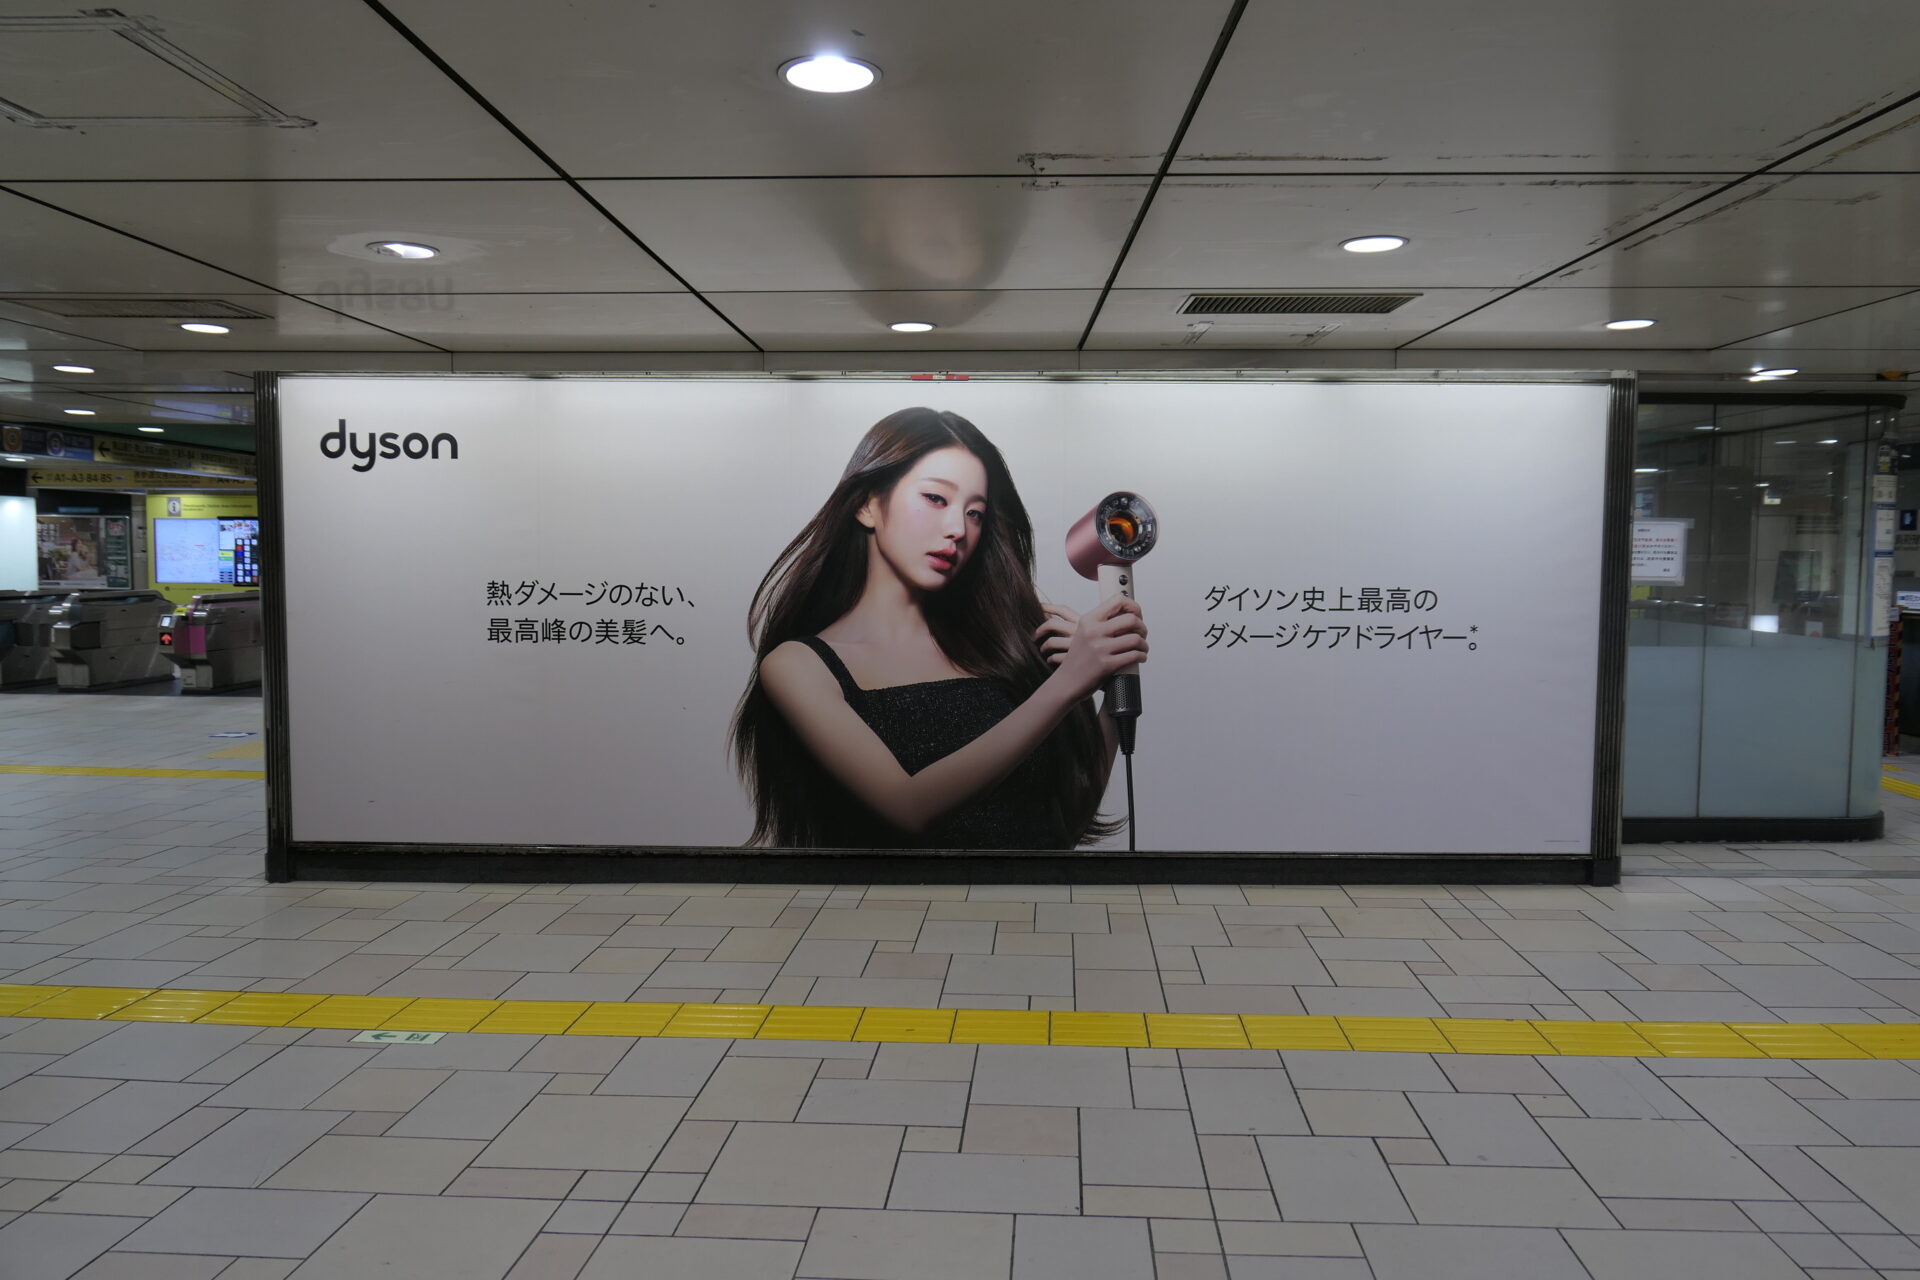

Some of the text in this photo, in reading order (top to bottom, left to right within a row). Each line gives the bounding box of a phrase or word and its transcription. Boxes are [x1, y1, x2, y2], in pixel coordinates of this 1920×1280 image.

[320, 419, 458, 473] dyson
[487, 580, 695, 608] 熱ダメージのない、
[1204, 585, 1439, 613] ダイソン史上最高の
[487, 618, 685, 646] 最高峰の美髪へ。
